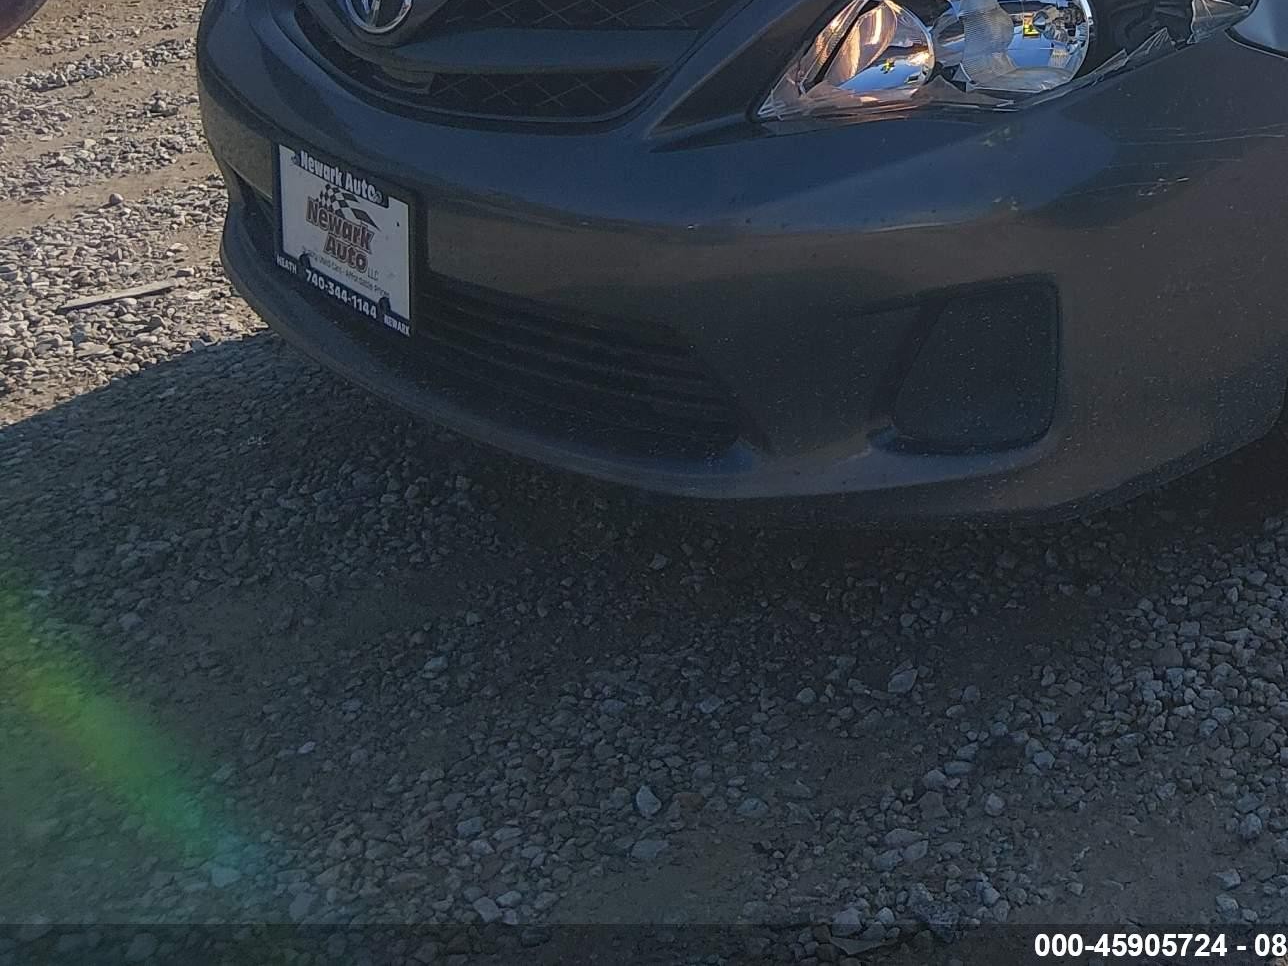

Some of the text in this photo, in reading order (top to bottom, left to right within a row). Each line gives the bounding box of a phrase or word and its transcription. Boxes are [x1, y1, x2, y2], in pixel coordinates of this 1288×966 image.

[300, 150, 376, 202] Newark Auto
[306, 197, 375, 253] Newark
[323, 231, 368, 274] Auto
[305, 269, 377, 319] 740-344-1144
